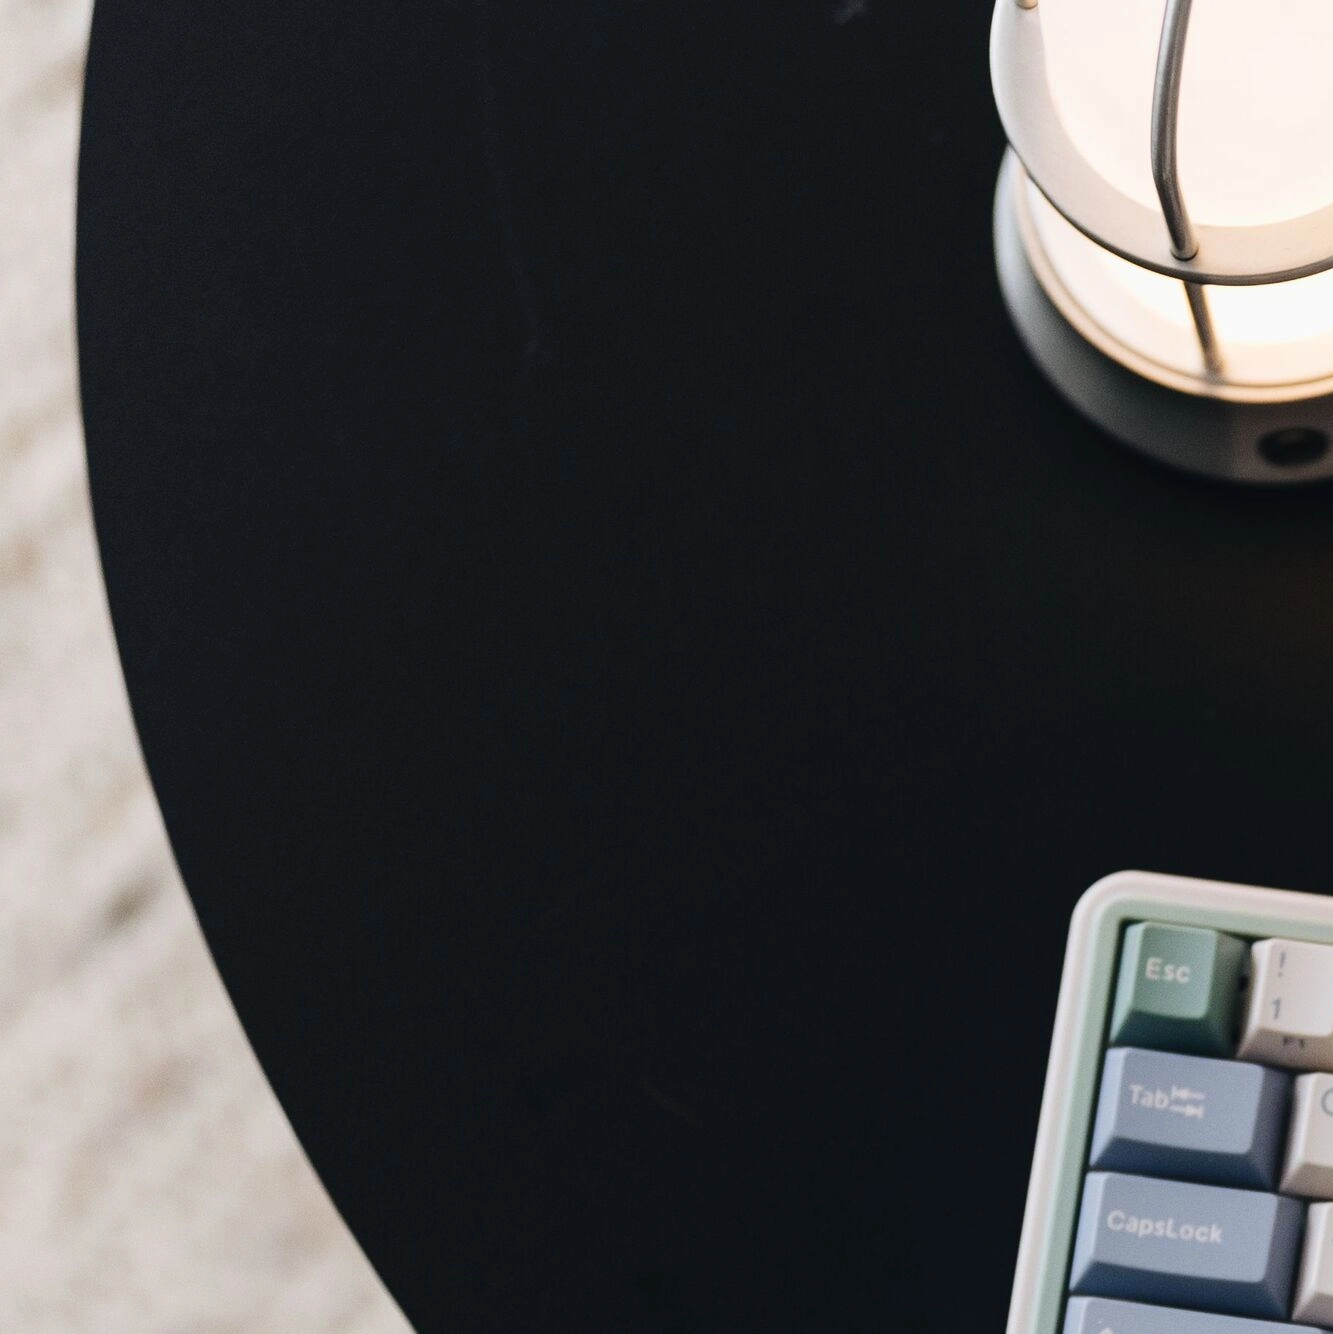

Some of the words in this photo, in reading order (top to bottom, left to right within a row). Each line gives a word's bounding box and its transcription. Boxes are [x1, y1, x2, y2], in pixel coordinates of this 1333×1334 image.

[1145, 957, 1190, 983] Esc
[1272, 998, 1282, 1020] 1
[1128, 1084, 1170, 1109] Tab
[1107, 1210, 1224, 1243] CapsLock
